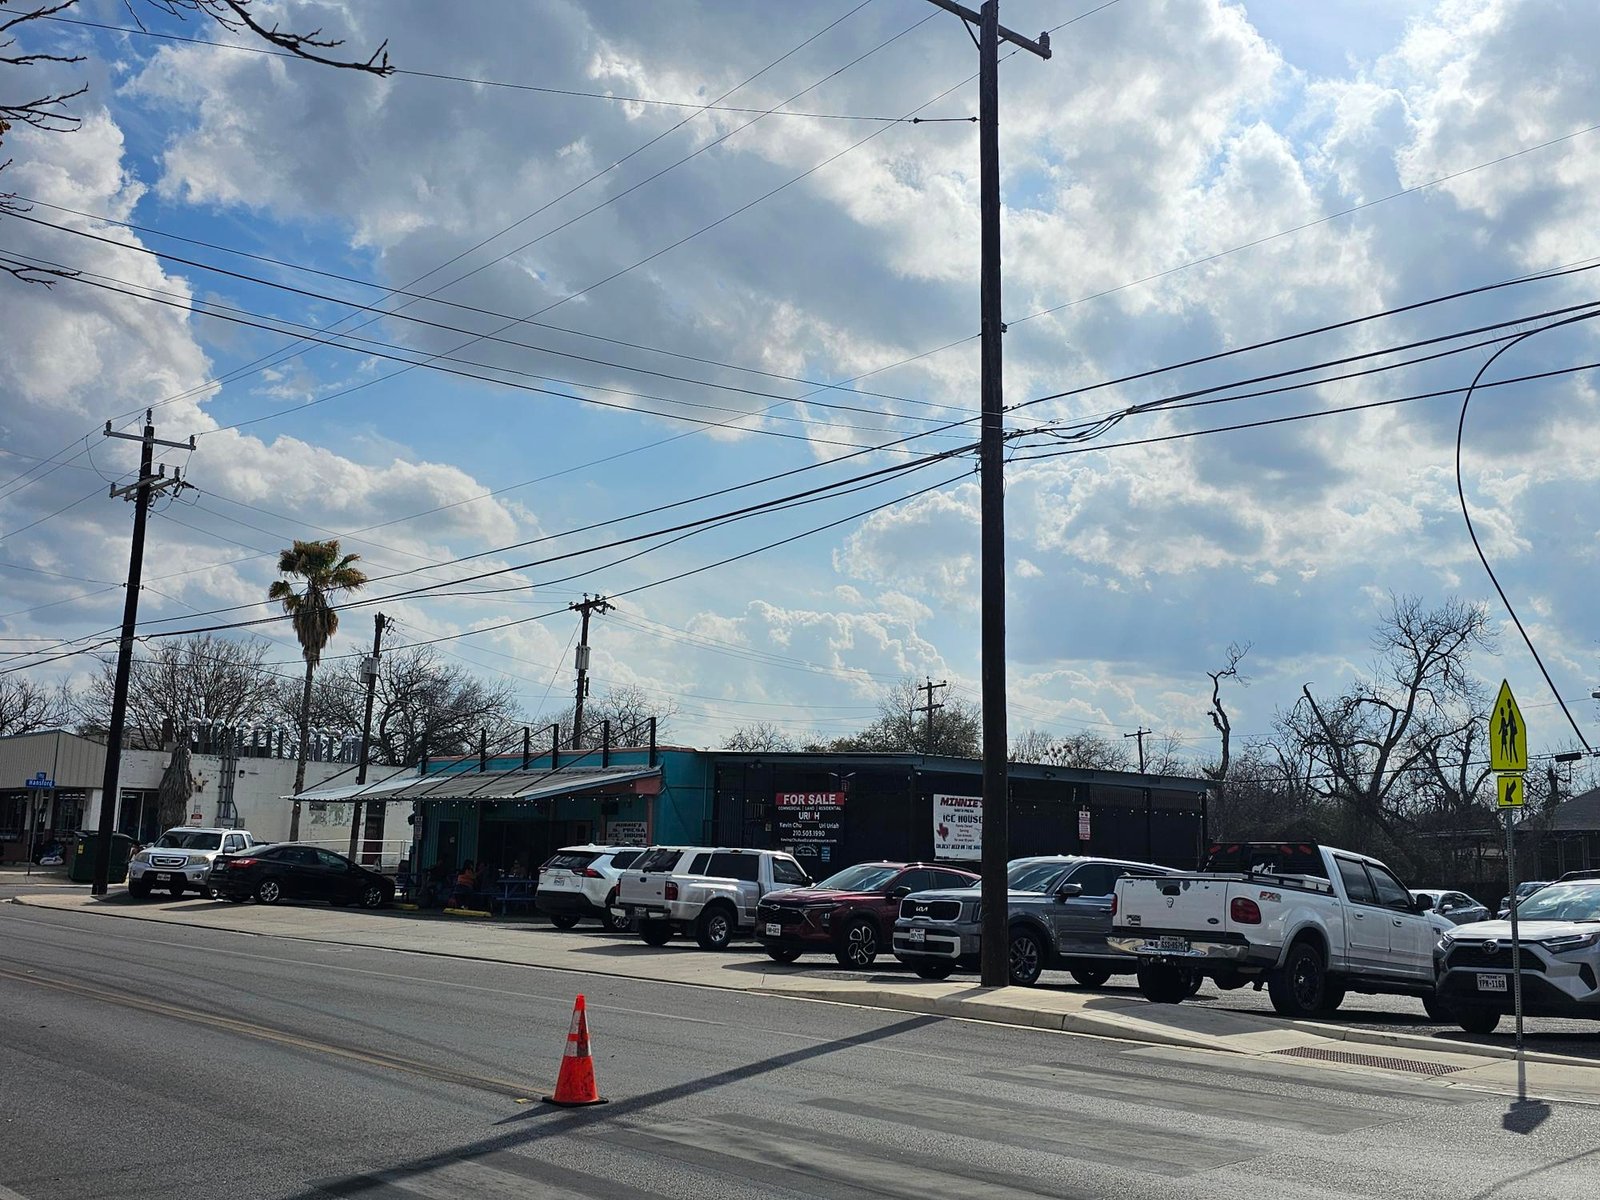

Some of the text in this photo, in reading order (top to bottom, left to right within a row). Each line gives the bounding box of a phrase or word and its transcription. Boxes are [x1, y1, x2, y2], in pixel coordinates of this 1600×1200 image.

[783, 794, 836, 805] FOR SALE
[942, 814, 956, 823] ICE
